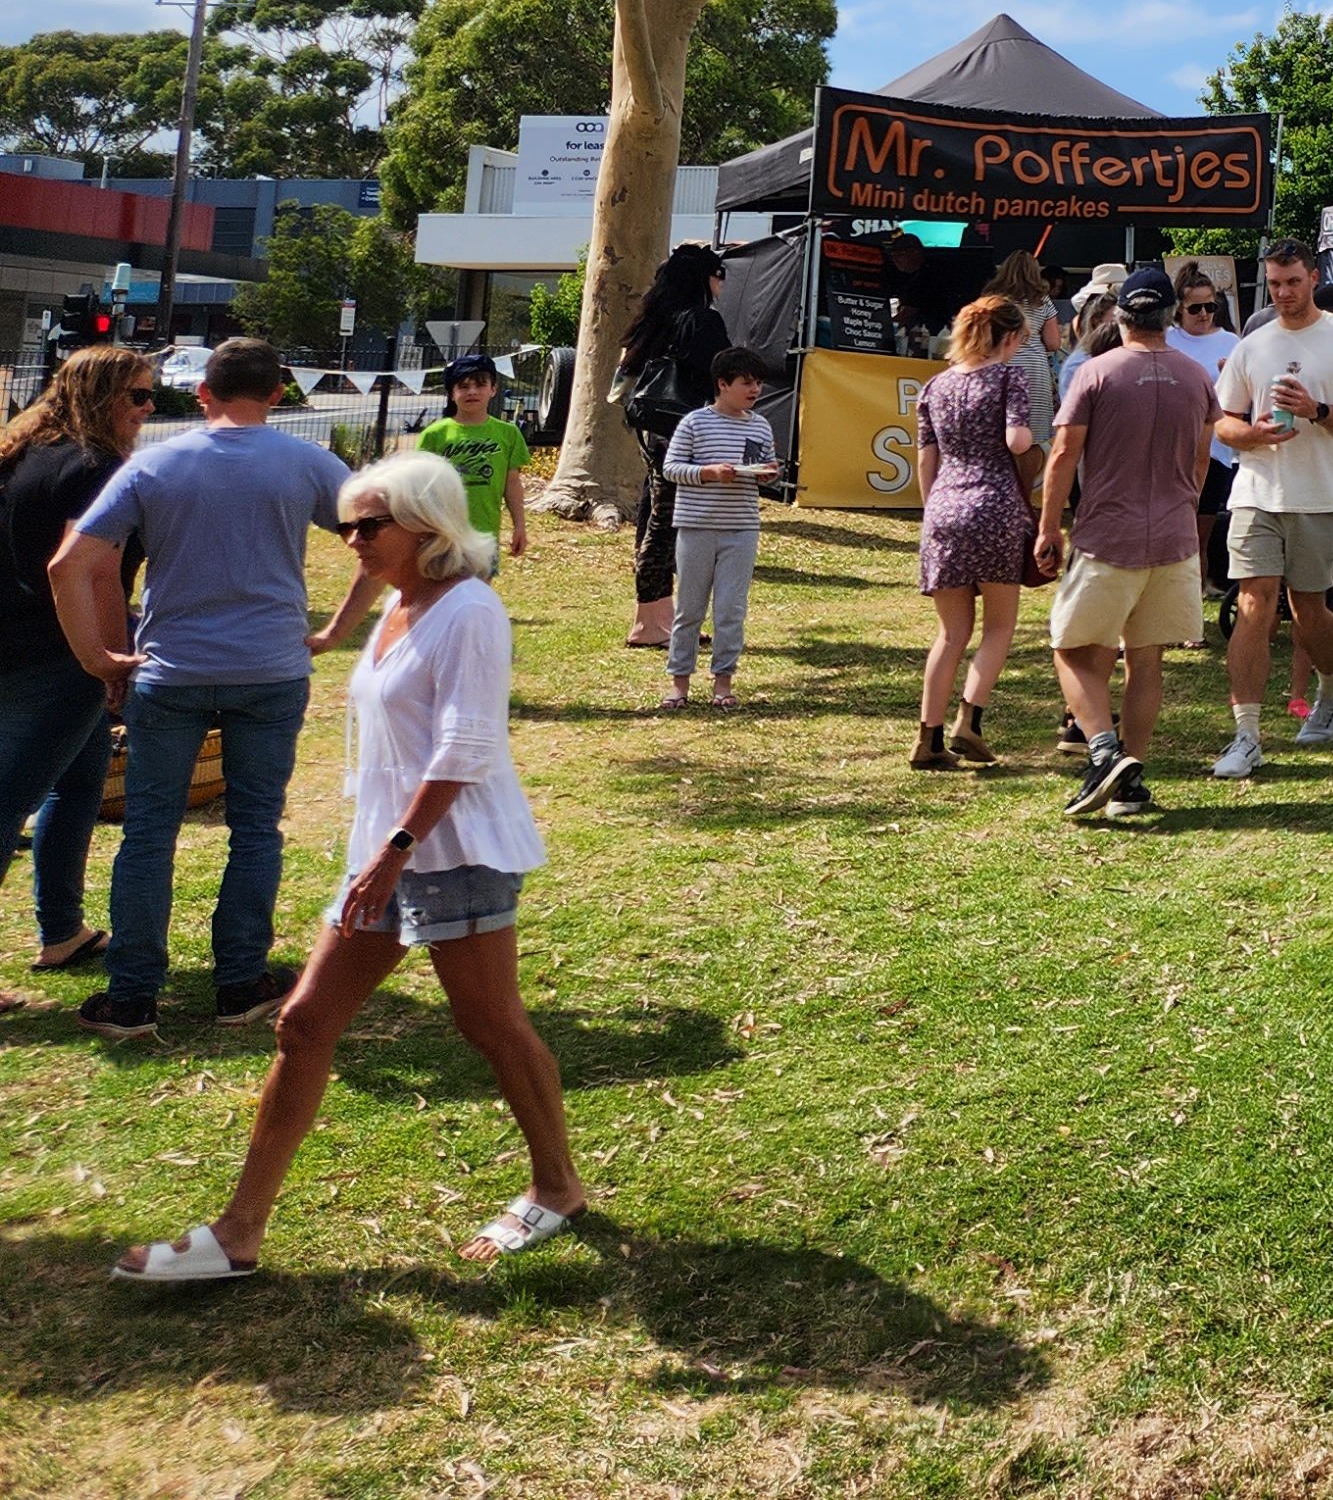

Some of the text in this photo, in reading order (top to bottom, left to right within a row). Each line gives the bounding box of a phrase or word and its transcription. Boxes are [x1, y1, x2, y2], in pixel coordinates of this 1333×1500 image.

[565, 140, 605, 150] for leas
[844, 116, 1251, 203] Mr. Poffertjes
[850, 182, 1111, 222] Mini dutch pancakes
[851, 308, 873, 319] Honey
